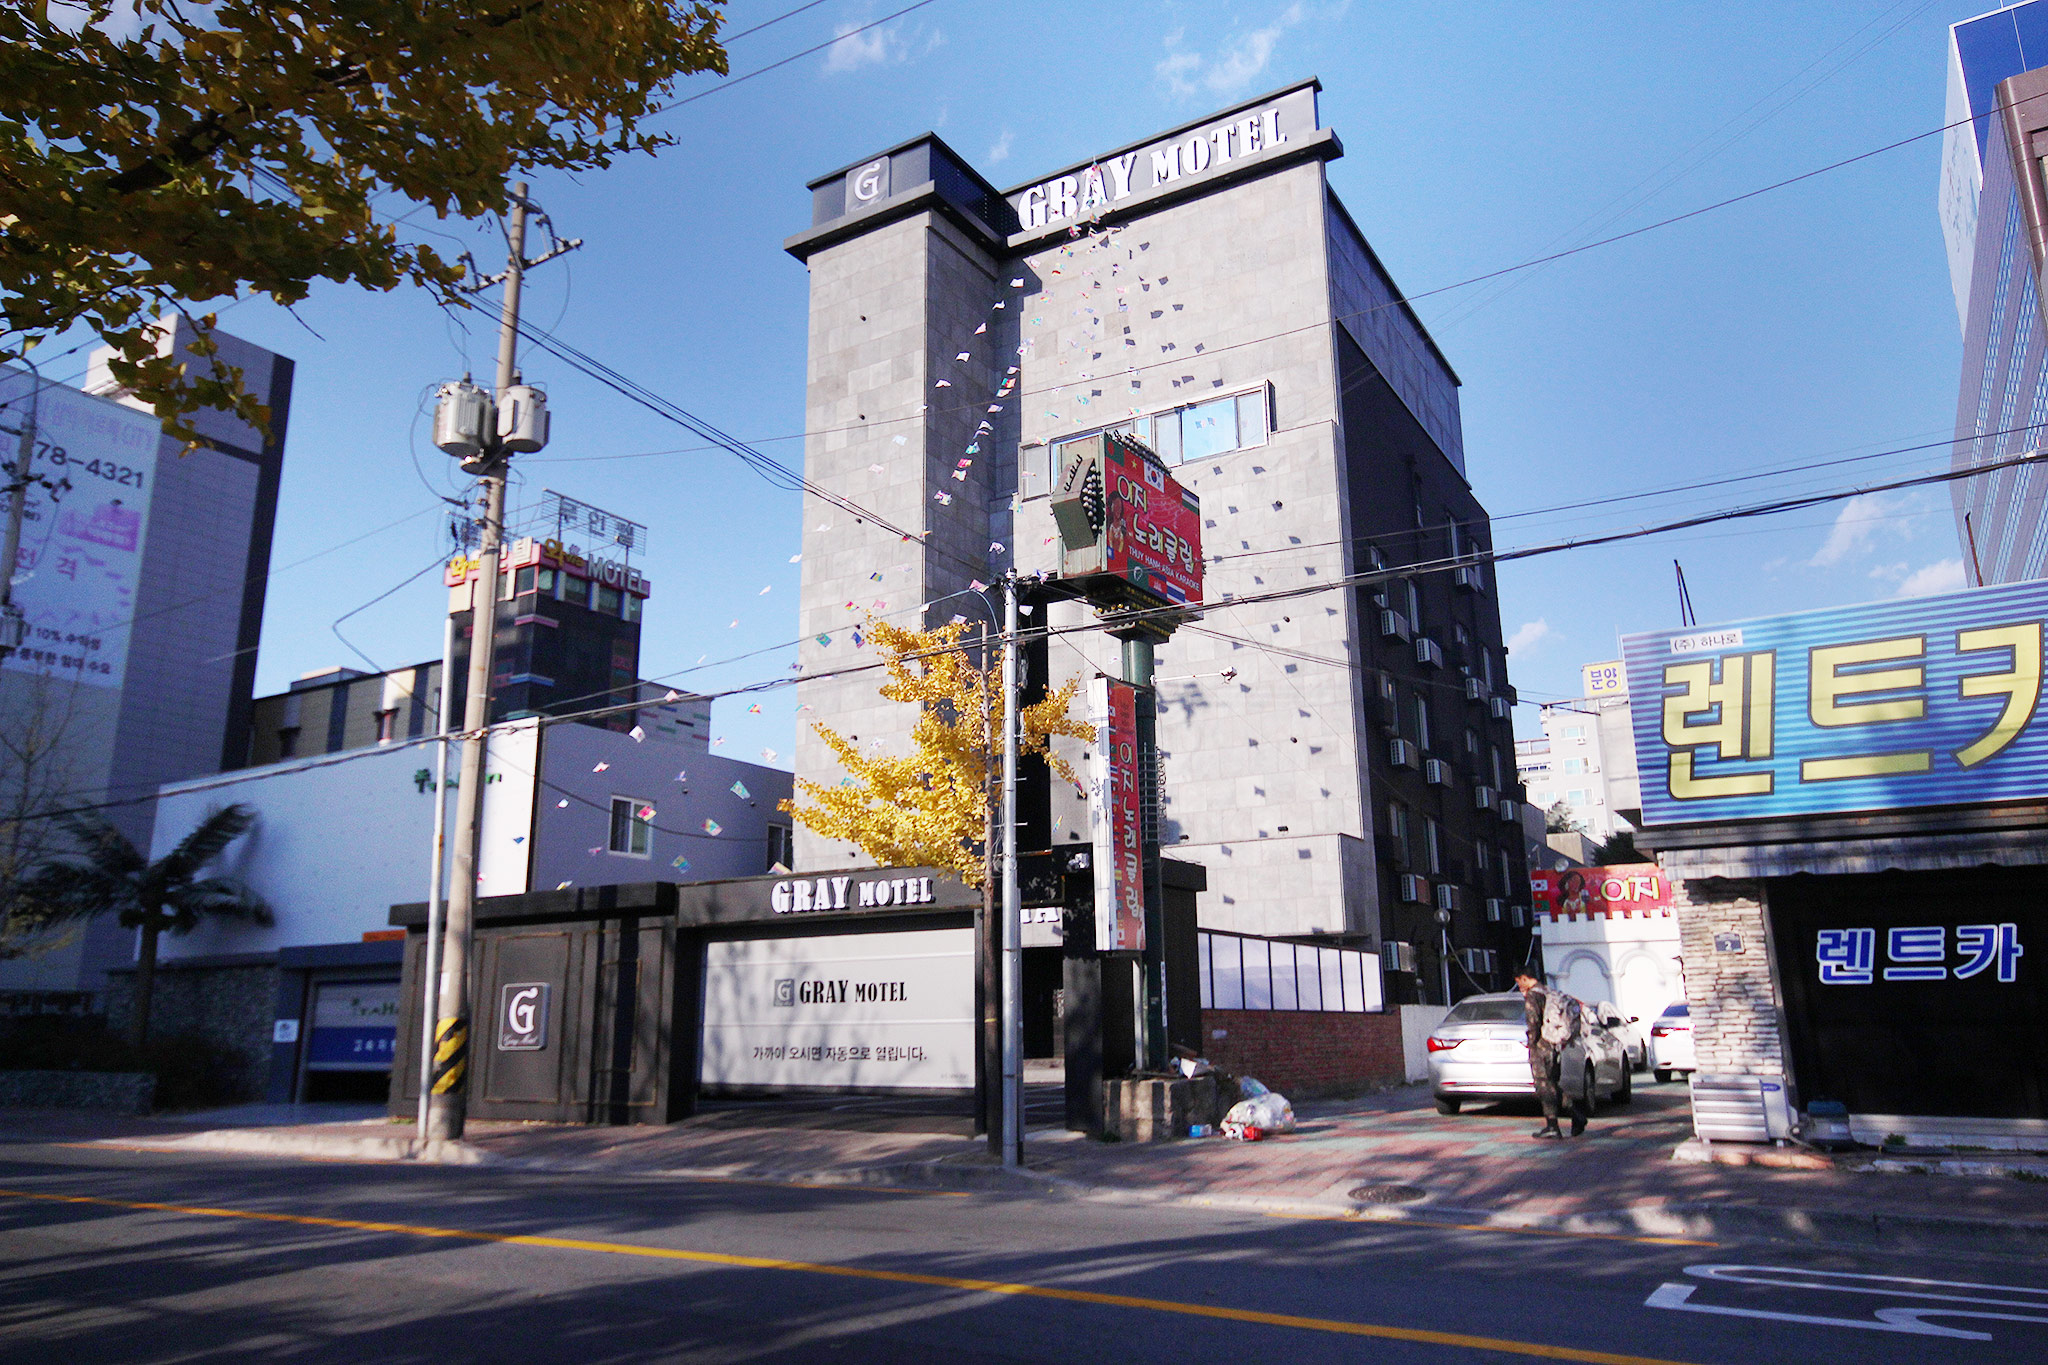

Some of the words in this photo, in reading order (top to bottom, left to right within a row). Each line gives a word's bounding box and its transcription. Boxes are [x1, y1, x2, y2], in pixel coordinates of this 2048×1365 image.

[854, 163, 881, 201] G
[1018, 152, 1137, 231] GRAY
[1151, 108, 1287, 187] MOTEL
[1132, 513, 1194, 574] 노래클럽
[587, 552, 643, 593] MOTEL
[1175, 571, 1200, 592] KARAOKE
[1674, 638, 1696, 652] (주)
[1700, 633, 1738, 647] 하나로
[1590, 668, 1618, 691] 분양
[771, 876, 854, 915] GRAY
[857, 876, 936, 907] MOTEL
[1816, 922, 2024, 985] 렌트카
[508, 987, 539, 1035] G
[799, 980, 849, 1004] GRAY
[855, 982, 908, 1003] MOTEL
[753, 1046, 786, 1061] 가까이
[789, 1046, 822, 1061] 오시면
[825, 1046, 871, 1061] 자동으로
[875, 1046, 928, 1062] 열립니다.
